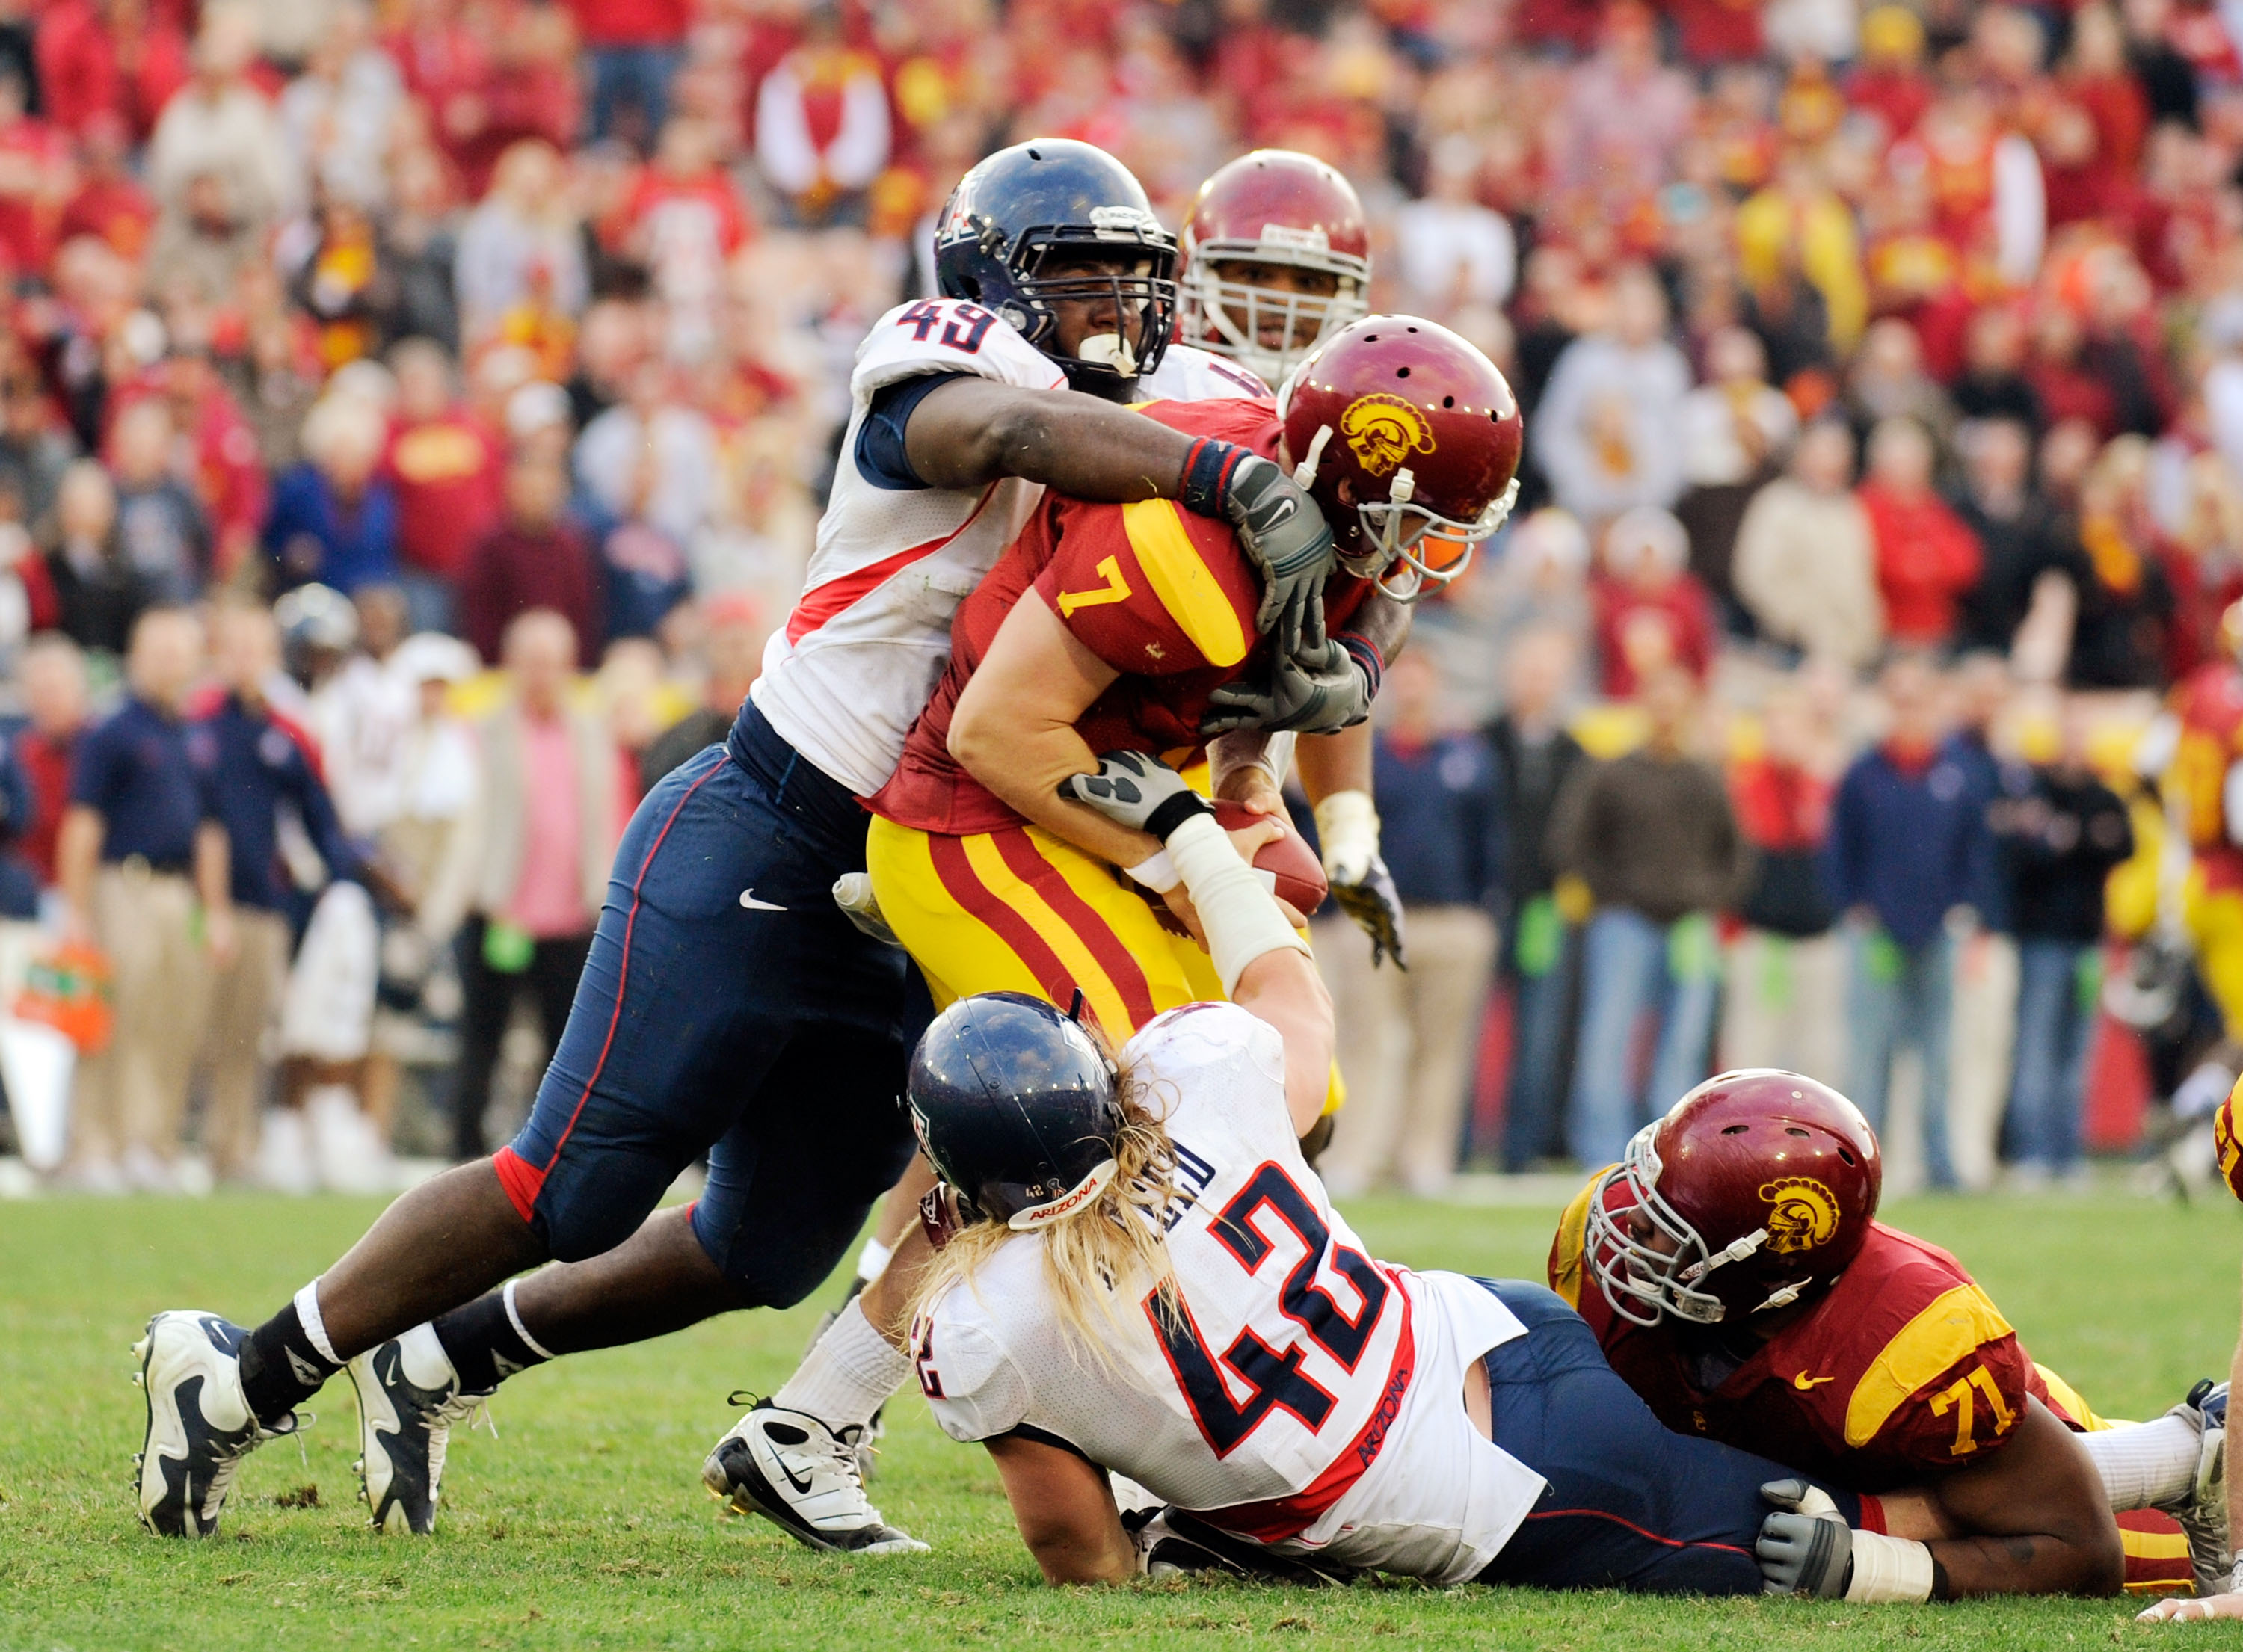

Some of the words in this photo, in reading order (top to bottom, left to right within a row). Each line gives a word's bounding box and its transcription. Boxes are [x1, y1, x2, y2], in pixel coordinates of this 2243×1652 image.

[896, 298, 998, 354] 49
[1056, 554, 1133, 619] 7
[1025, 1184, 1044, 1198] 42
[1030, 1177, 1098, 1221] ARIZONA
[1140, 1162, 1389, 1461] 42
[1357, 1369, 1409, 1470] ARIZONA
[1928, 1364, 2016, 1456] 71
